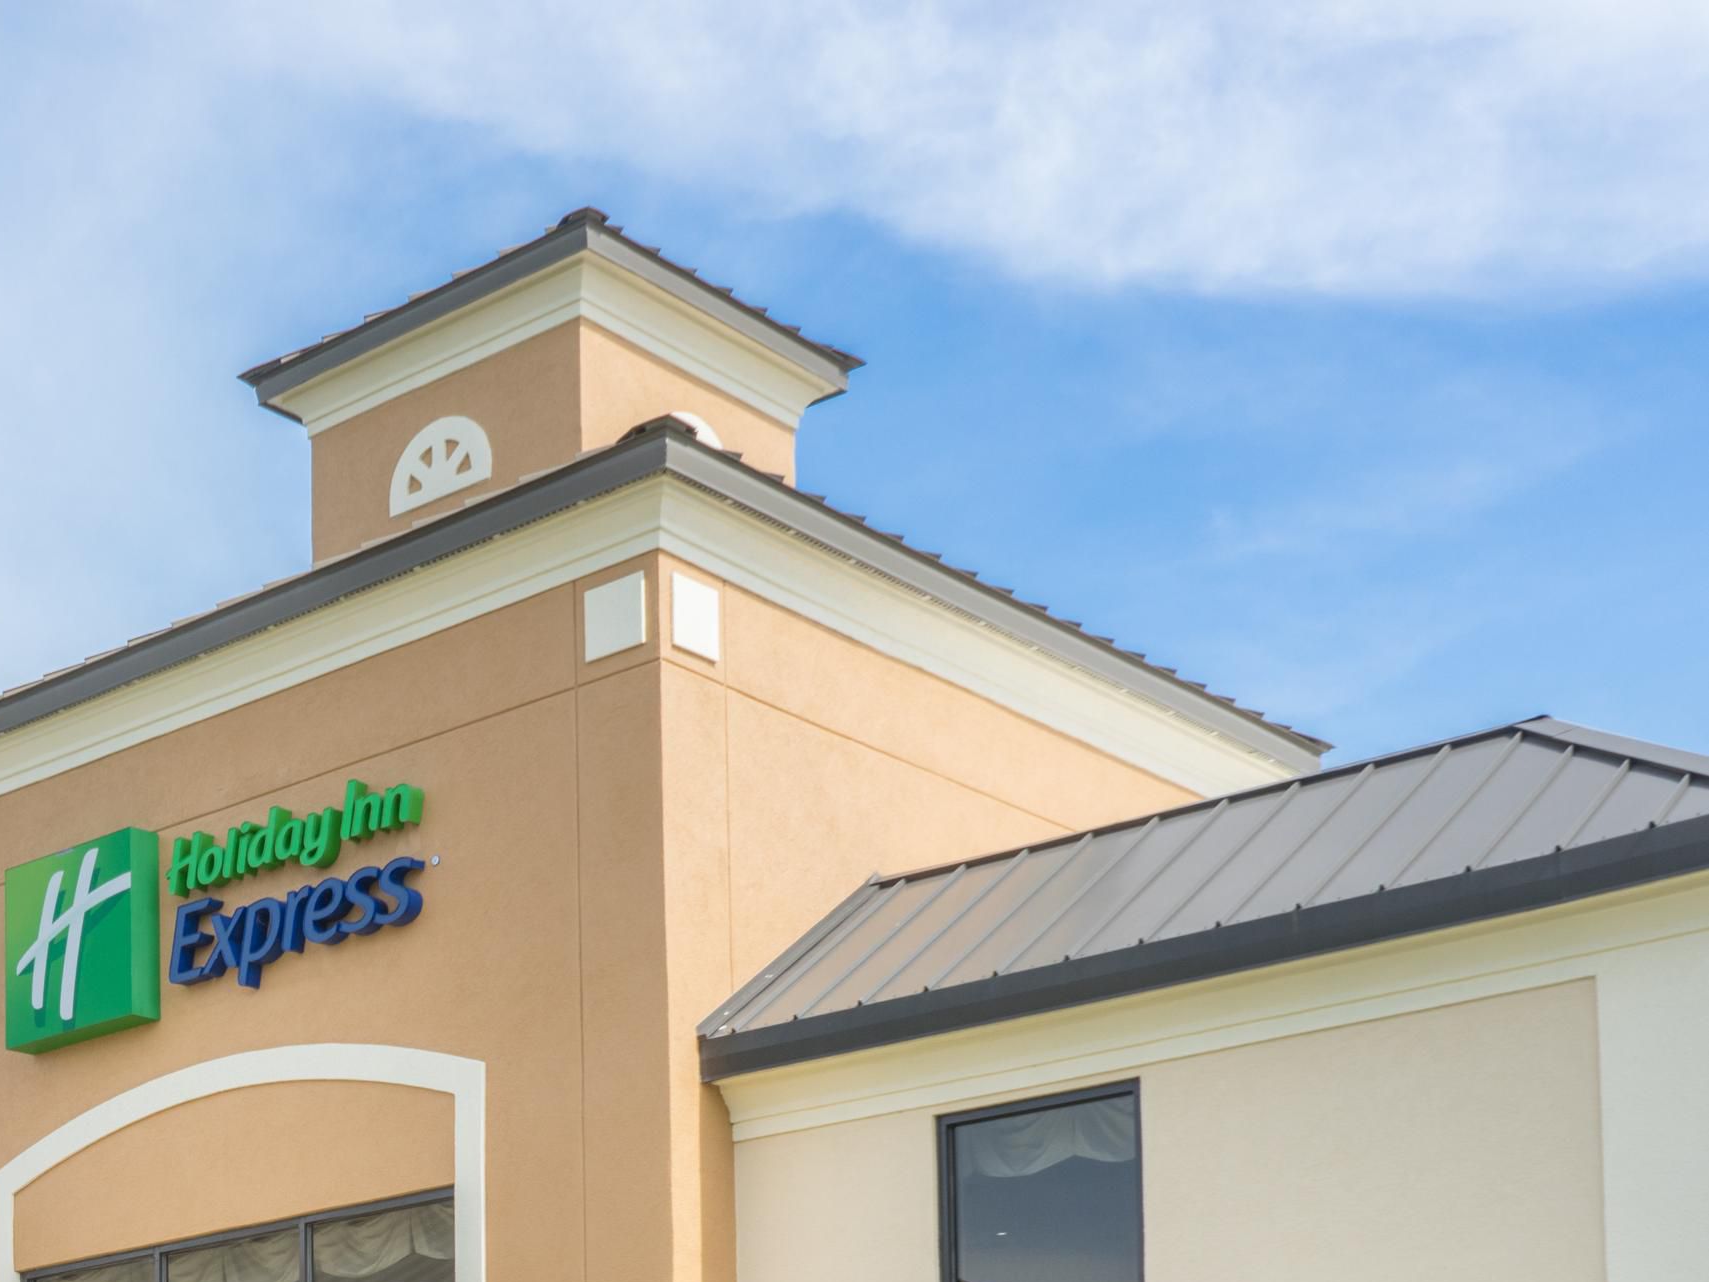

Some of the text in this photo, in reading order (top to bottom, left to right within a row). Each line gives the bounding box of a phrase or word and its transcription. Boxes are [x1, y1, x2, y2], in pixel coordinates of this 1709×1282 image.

[166, 779, 425, 897] Holiday Inn
[168, 856, 425, 989] Express
